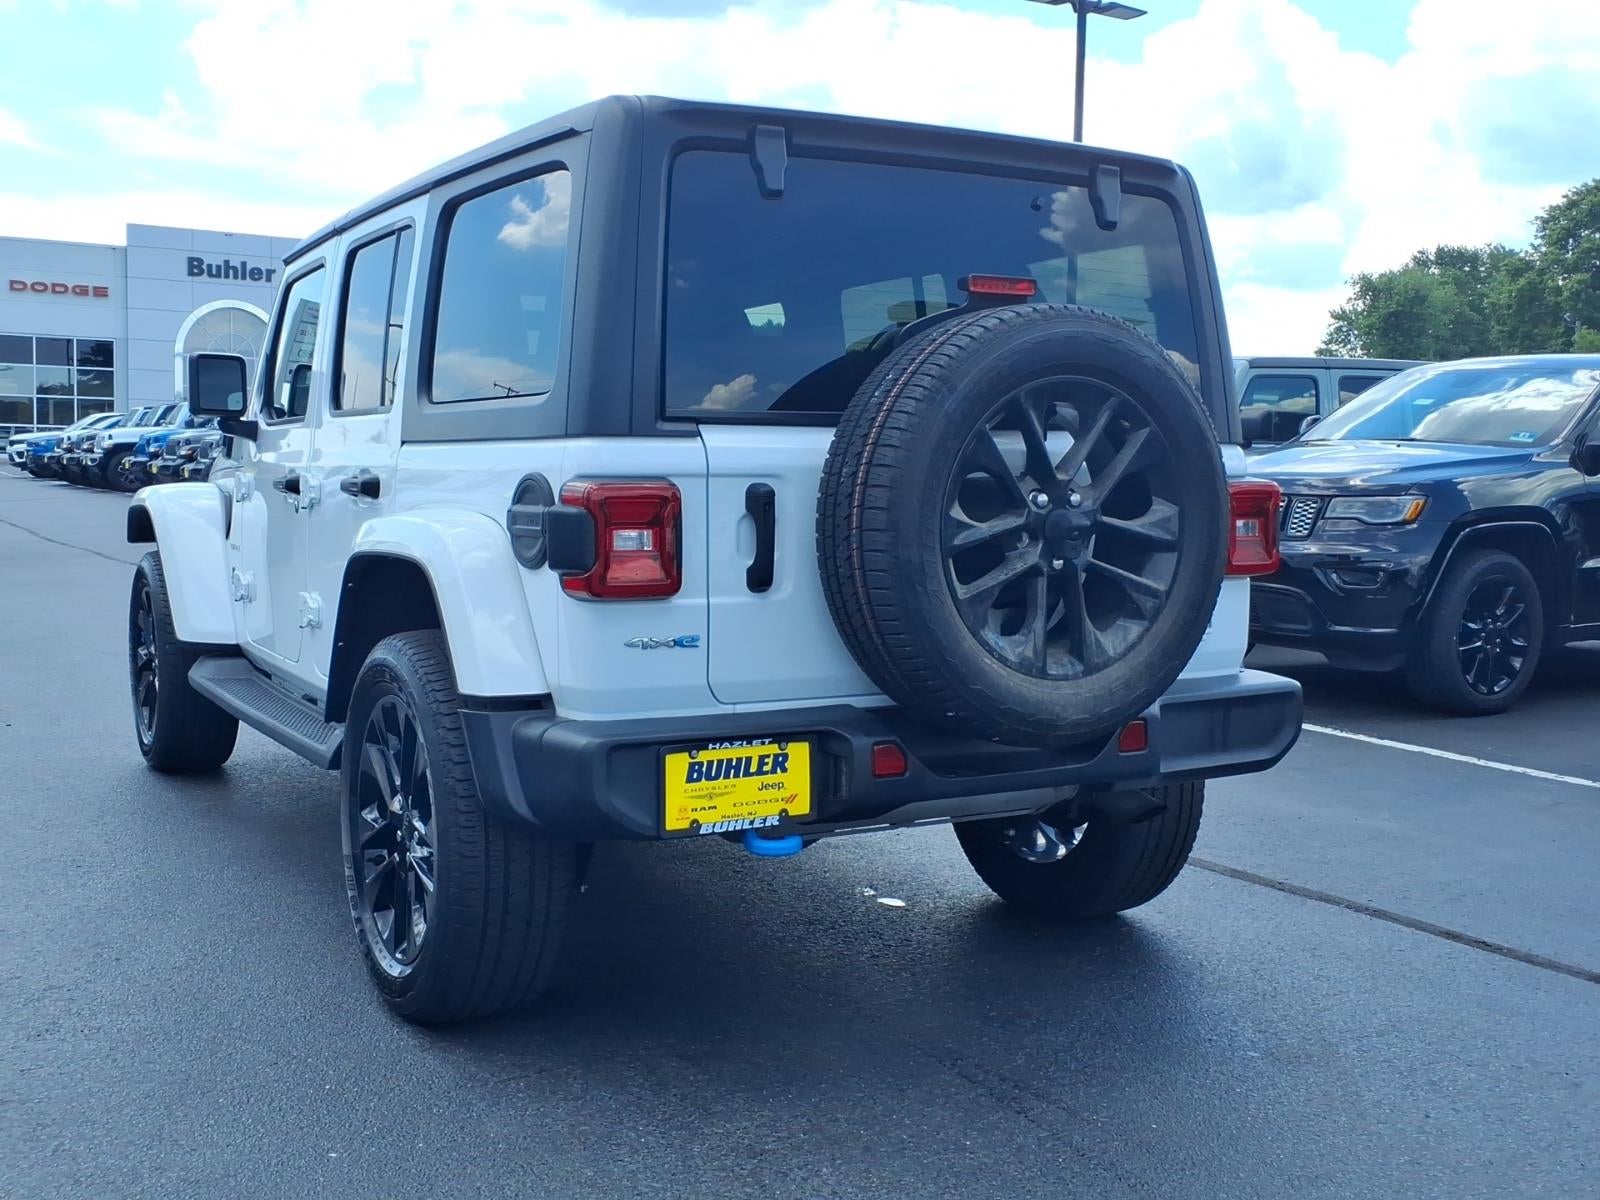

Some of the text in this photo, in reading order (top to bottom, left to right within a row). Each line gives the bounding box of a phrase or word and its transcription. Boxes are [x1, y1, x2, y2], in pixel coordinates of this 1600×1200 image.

[187, 256, 276, 283] Buhler
[9, 279, 109, 298] DODGE
[708, 738, 773, 750] HAZLET
[685, 752, 789, 784] BUHLER
[683, 783, 737, 794] CHRYSLER
[757, 781, 785, 792] Jeep
[732, 796, 788, 808] DODGE
[691, 804, 718, 813] RAM
[699, 815, 780, 834] BUHLER
